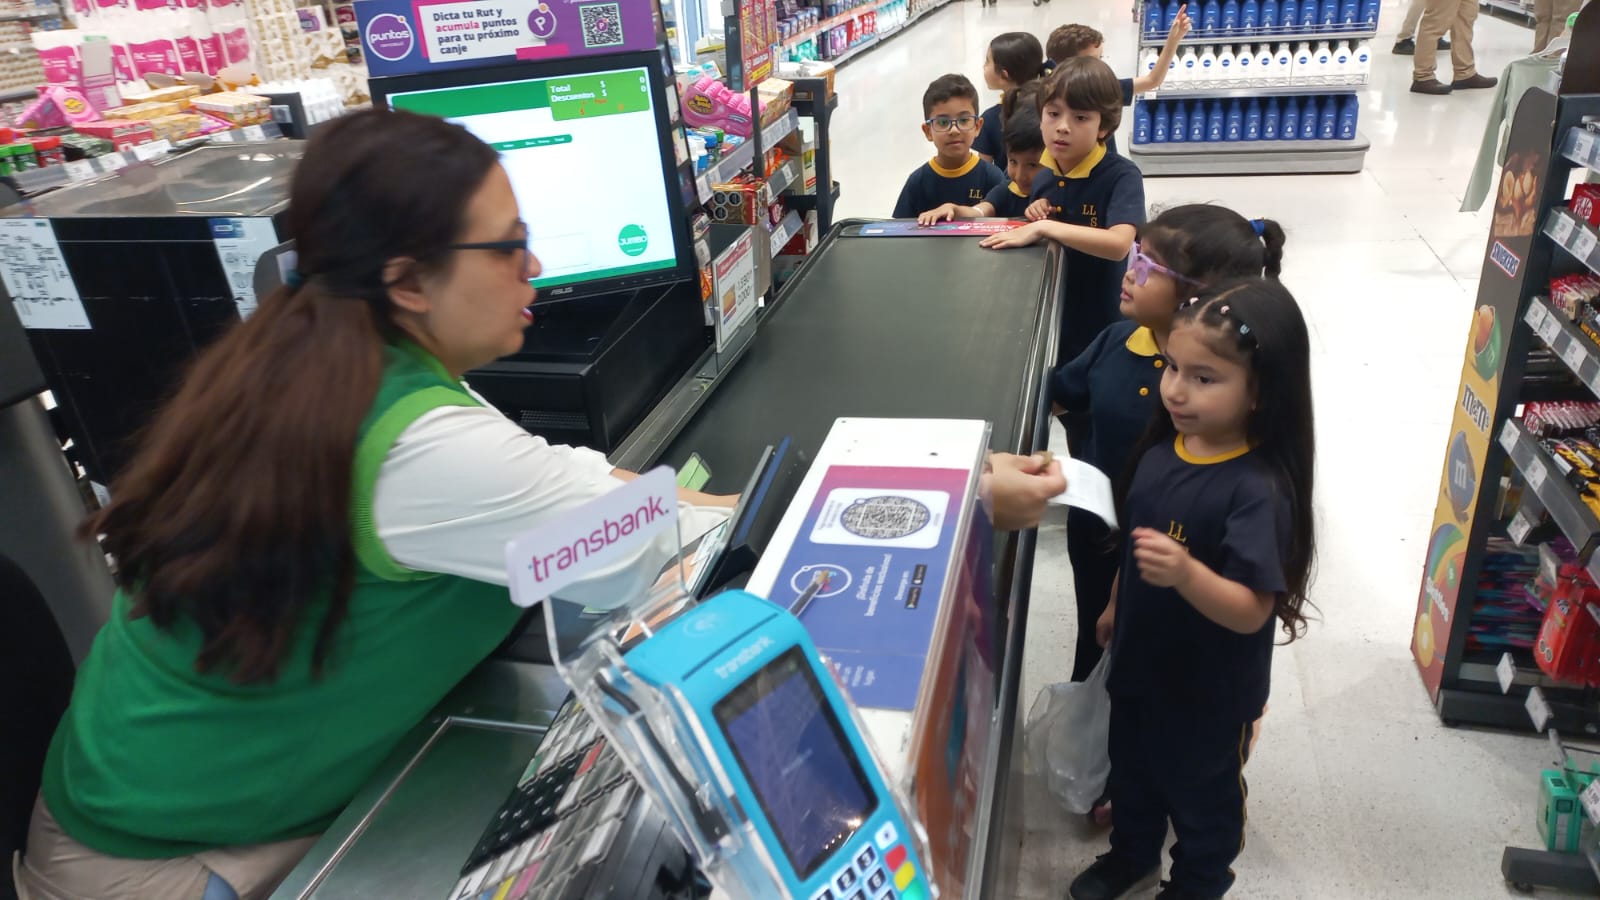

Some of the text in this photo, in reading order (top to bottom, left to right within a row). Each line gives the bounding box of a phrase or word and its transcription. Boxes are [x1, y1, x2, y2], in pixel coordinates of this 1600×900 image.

[433, 8, 503, 22] Dicta tu Rut y
[436, 18, 517, 32] acumula puntos
[370, 29, 410, 44] puntos
[438, 29, 519, 45] para tu próximo
[440, 45, 468, 55] canje
[550, 84, 571, 93] Total
[600, 80, 606, 88] $
[551, 92, 595, 102] Descuentos
[602, 89, 607, 97] $
[969, 189, 983, 199] LL
[1082, 204, 1097, 216] LL
[1090, 217, 1097, 227] S
[550, 287, 574, 296] ASUS
[1168, 520, 1187, 543] LL
[861, 853, 872, 867] 3
[841, 875, 852, 888] 2
